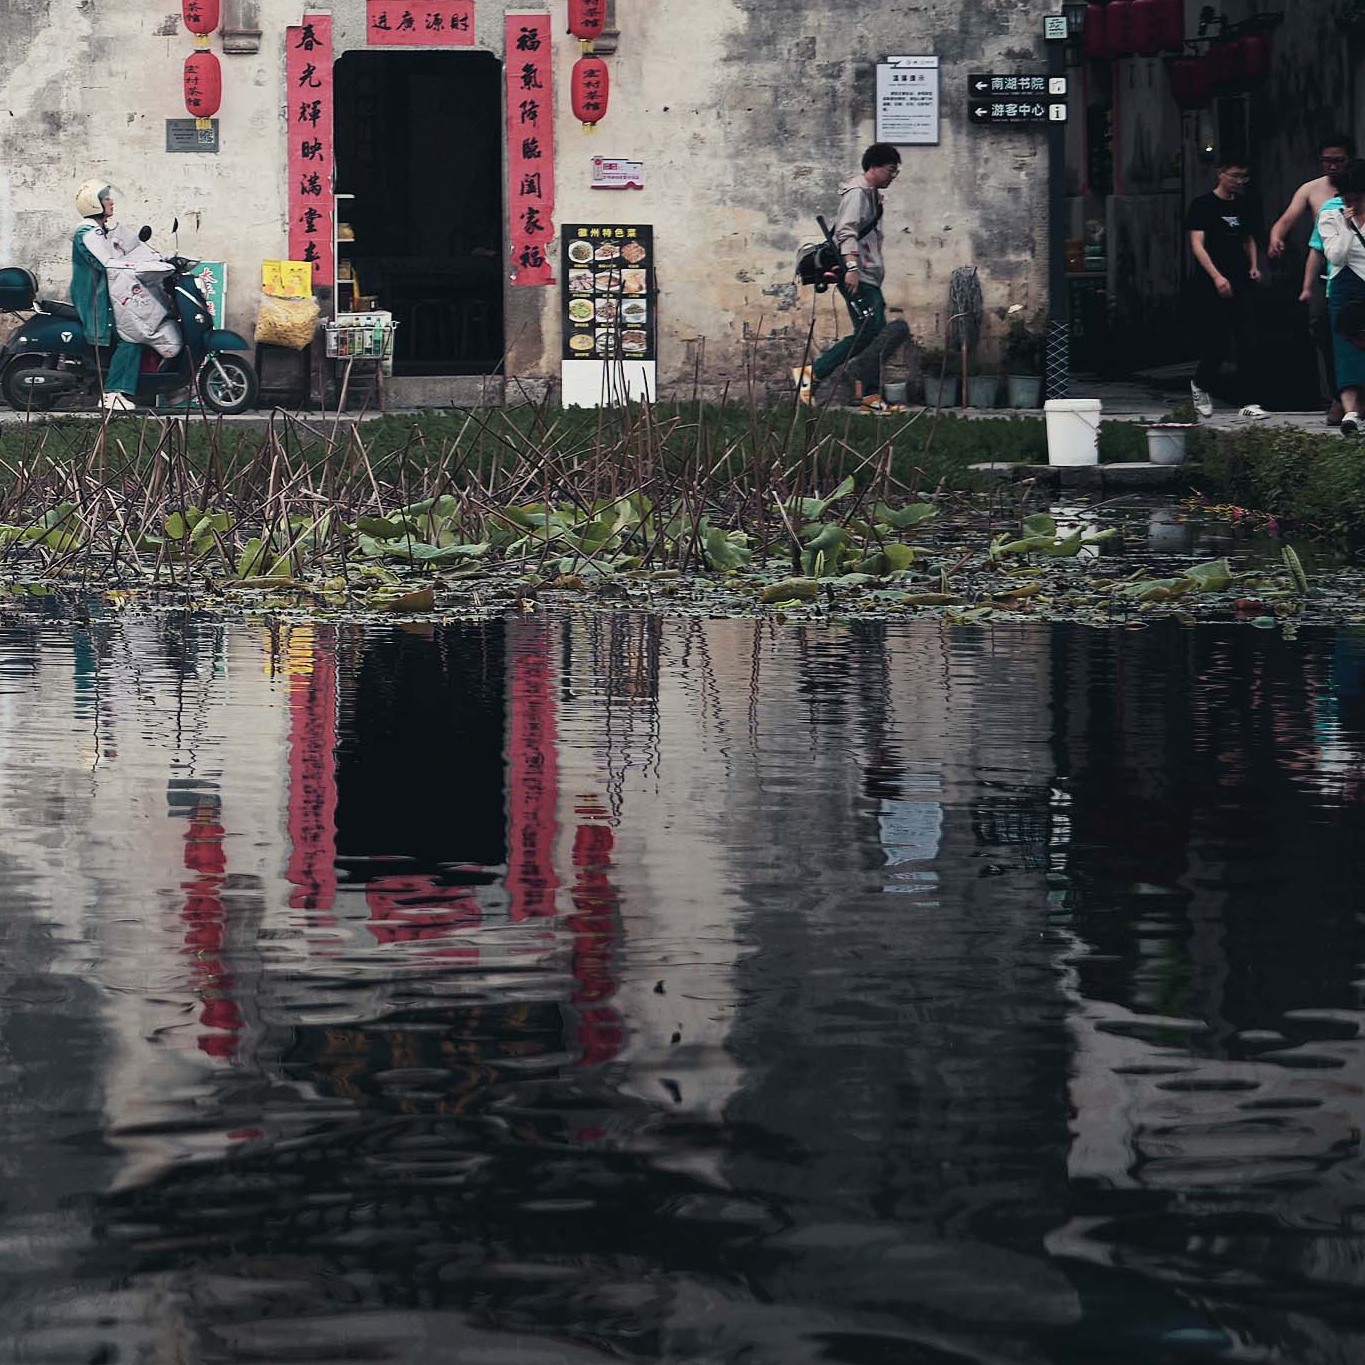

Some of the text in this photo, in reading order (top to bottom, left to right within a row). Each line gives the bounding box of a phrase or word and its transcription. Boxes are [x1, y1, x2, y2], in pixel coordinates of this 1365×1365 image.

[991, 77, 1045, 90] 南湖书院
[991, 103, 1045, 116] 游客中心
